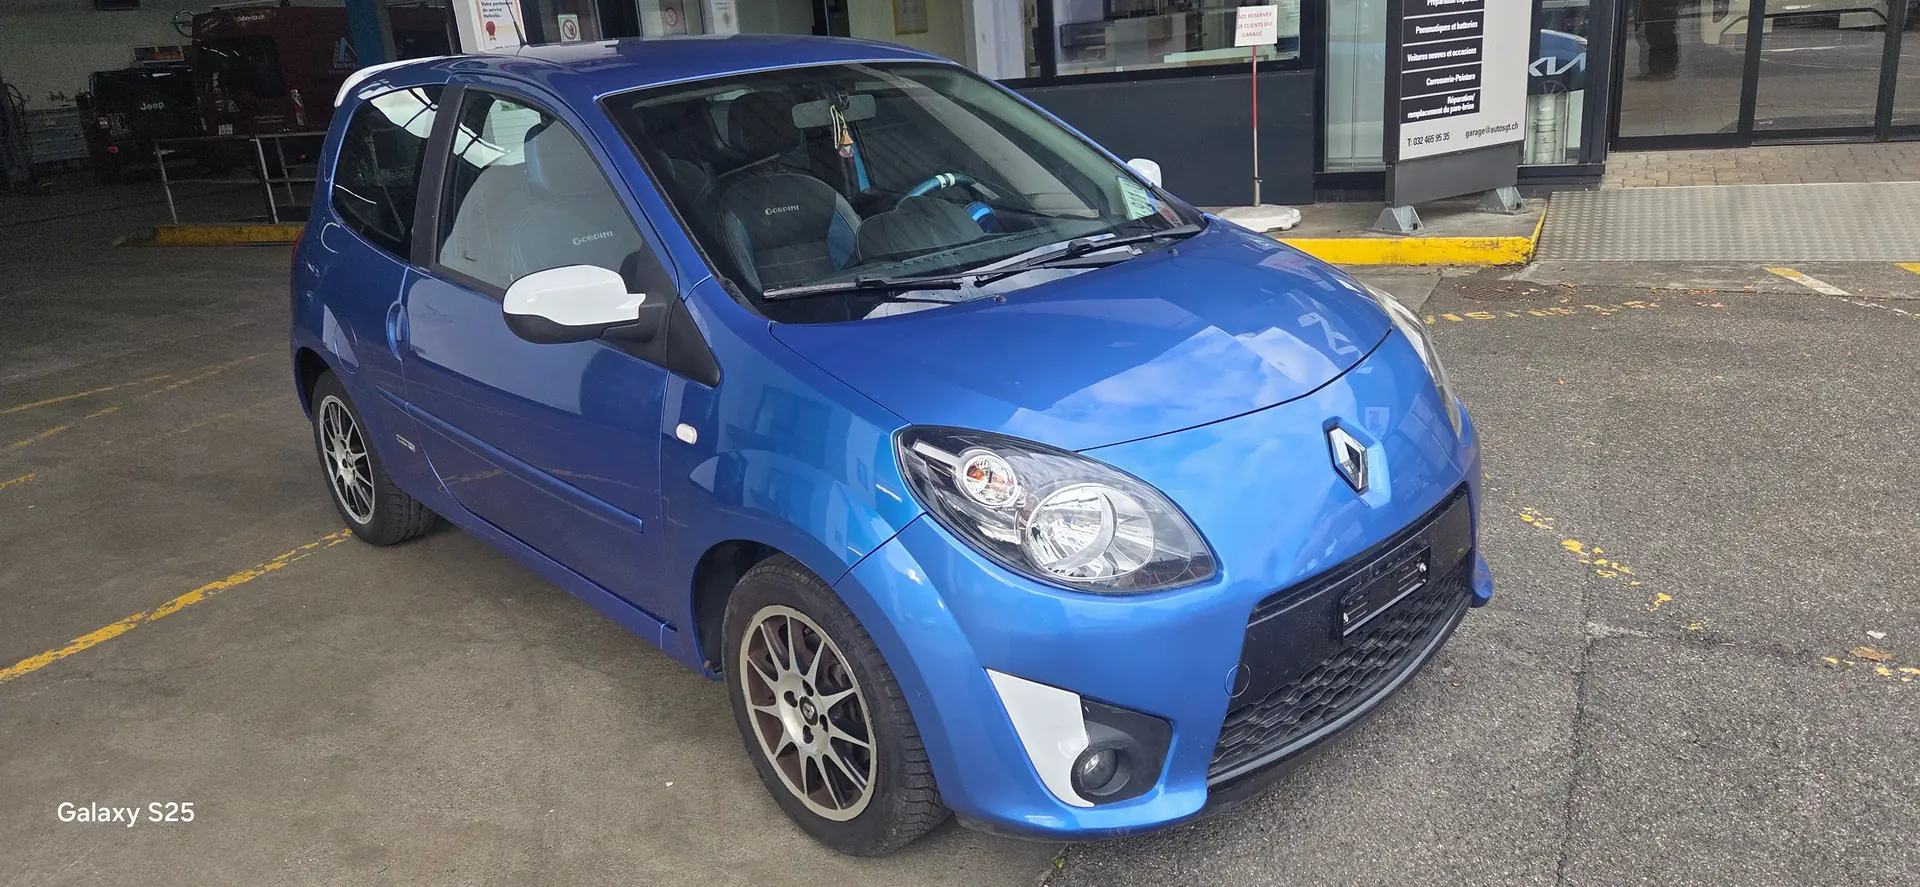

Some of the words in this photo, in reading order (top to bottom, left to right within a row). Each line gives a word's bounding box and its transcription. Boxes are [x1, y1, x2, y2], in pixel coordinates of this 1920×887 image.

[1415, 23, 1450, 34] Pneumatiques
[1451, 22, 1456, 30] et
[1457, 20, 1478, 30] batteries
[1407, 52, 1428, 62] Voitures
[1429, 50, 1446, 60] neuves
[1447, 49, 1452, 57] et
[1452, 47, 1477, 56] occasions
[1426, 73, 1476, 86] Carrosserie-Peinture
[140, 101, 165, 111] Jeep
[1447, 93, 1476, 105] Réparation/
[1407, 106, 1443, 119] remplacement
[1443, 105, 1449, 113] du
[1450, 102, 1475, 114] pare-brise
[1465, 121, 1519, 139] garage@autosgt.ch
[1407, 138, 1412, 146] T:
[1413, 136, 1424, 146] 032
[1425, 134, 1435, 144] 465
[1435, 133, 1442, 142] 95
[1442, 132, 1450, 141] 35
[764, 204, 800, 216] GORDINI
[572, 230, 614, 246] GORDINI
